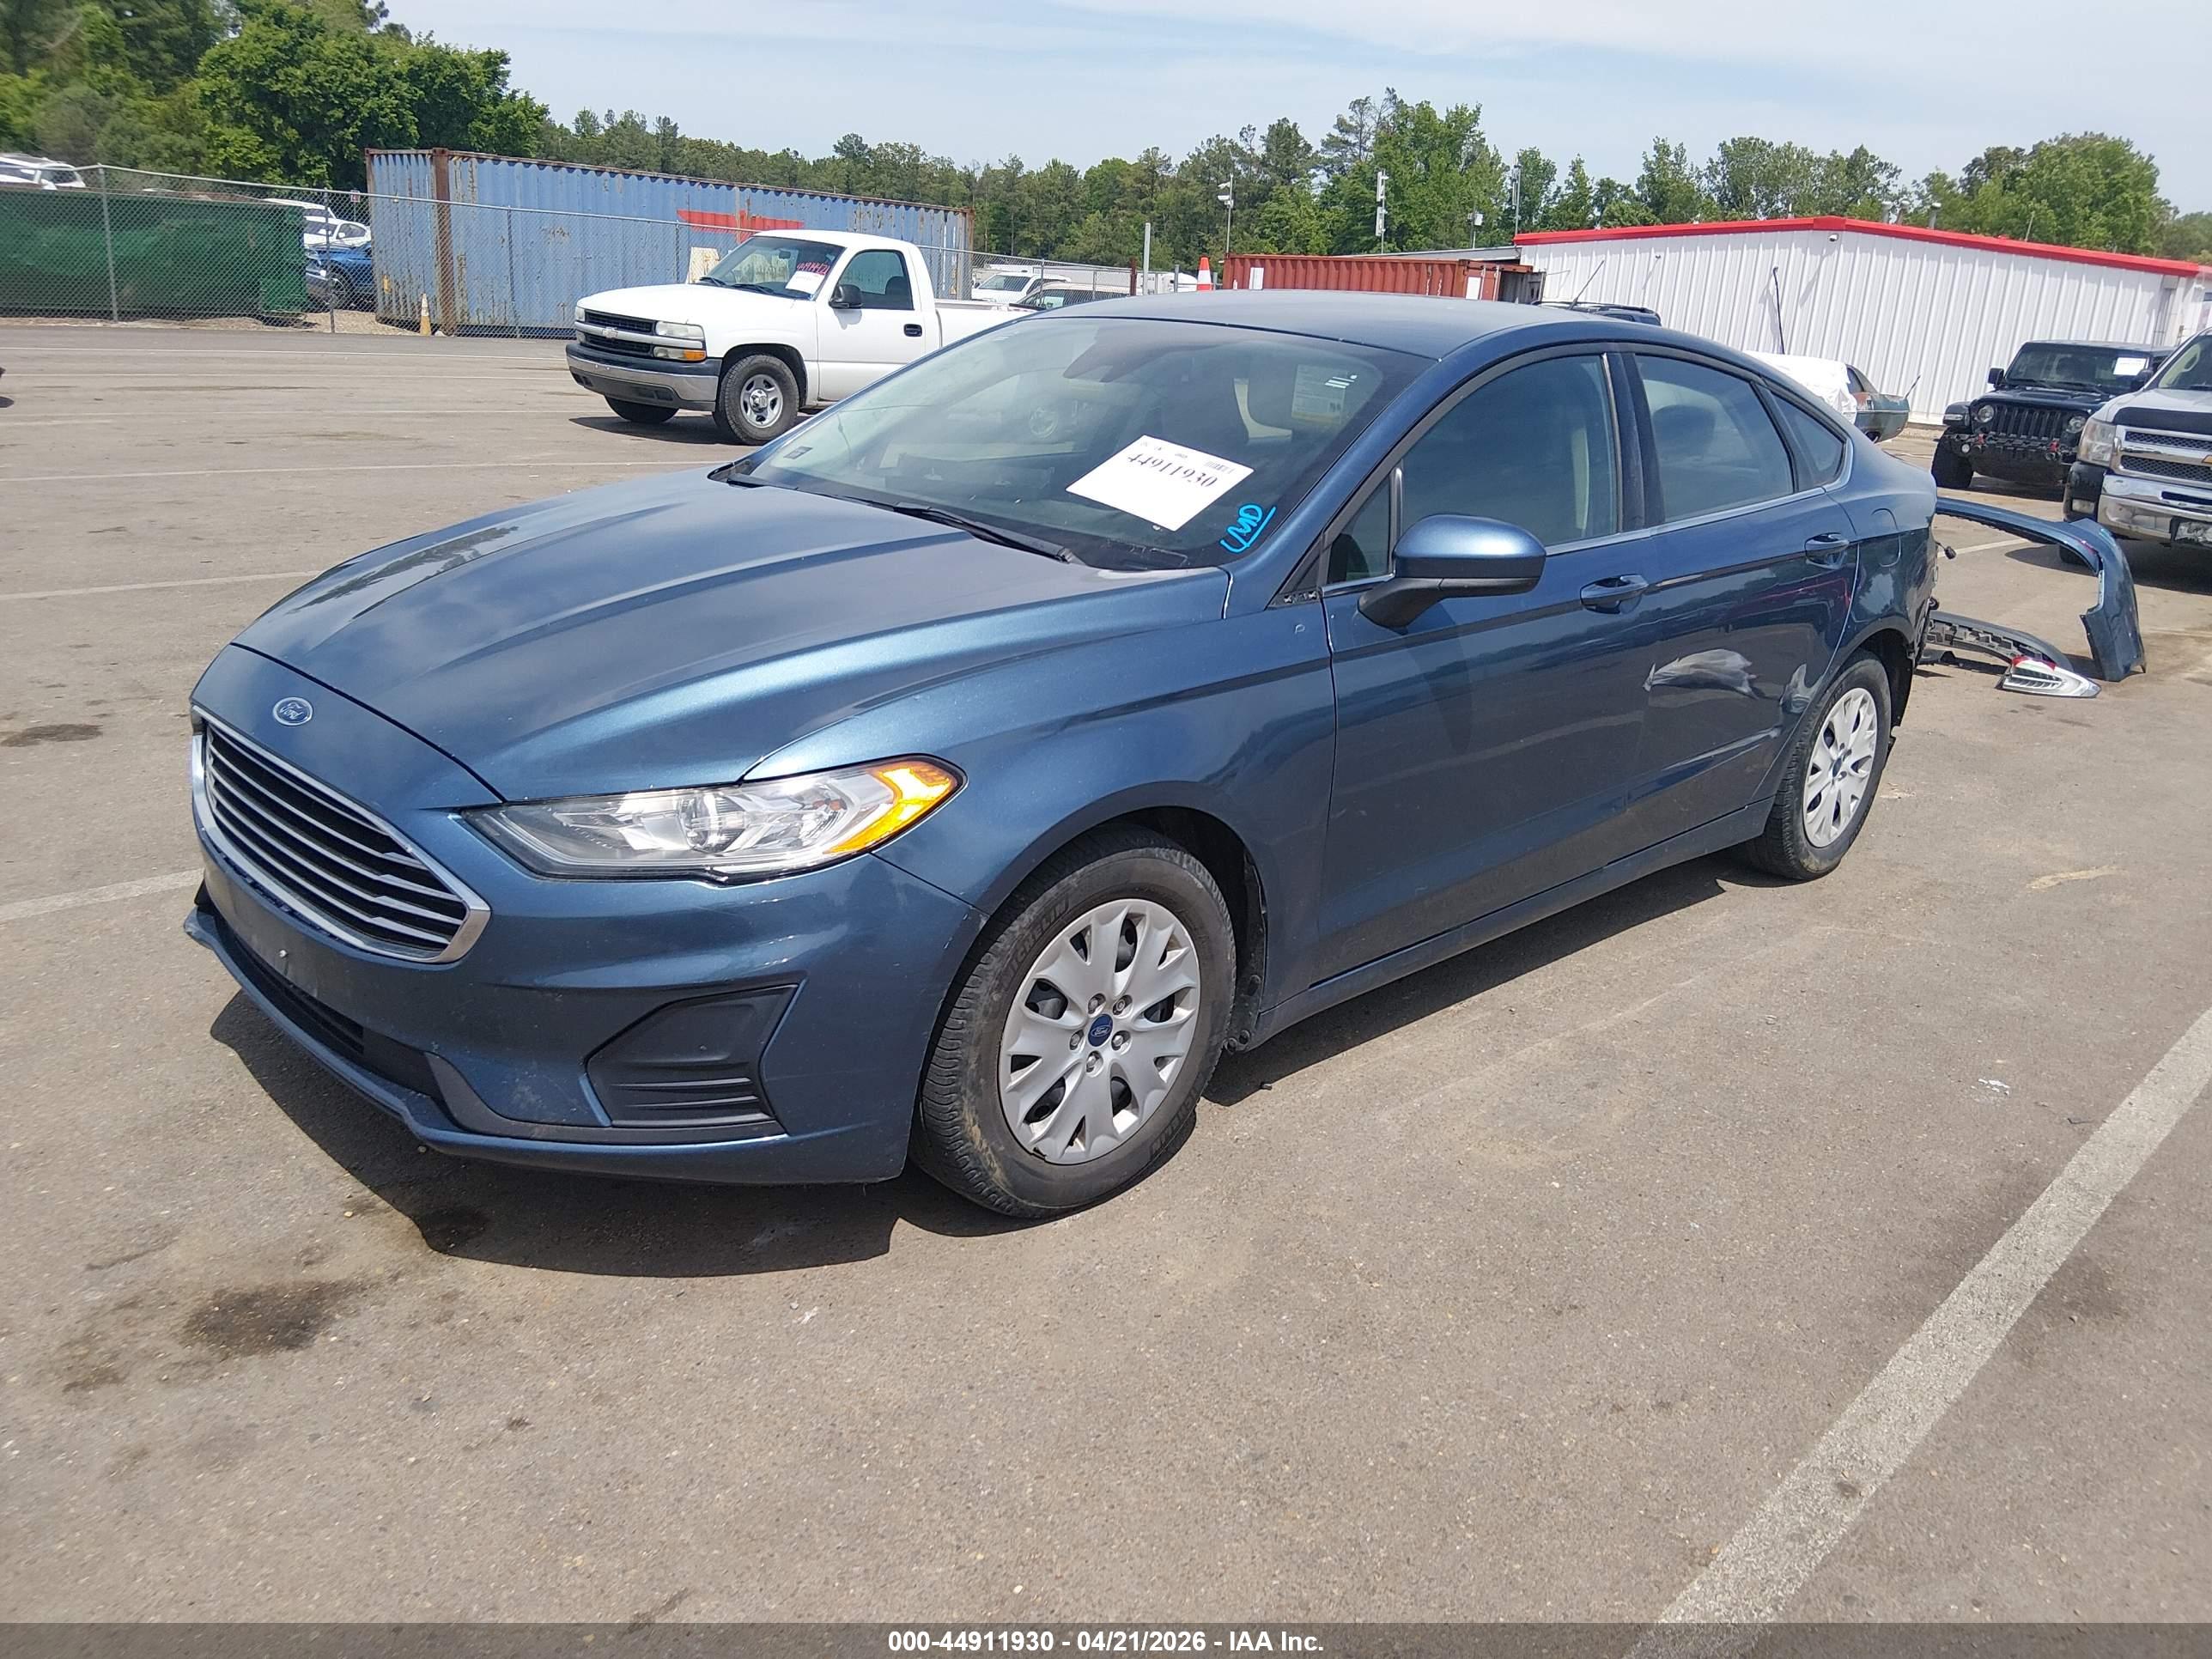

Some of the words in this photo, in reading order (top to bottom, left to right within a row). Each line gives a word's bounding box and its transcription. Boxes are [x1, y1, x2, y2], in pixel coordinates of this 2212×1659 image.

[1127, 453, 1218, 487] 44911930
[278, 701, 305, 720] Ford
[1092, 1025, 1109, 1036] Ford
